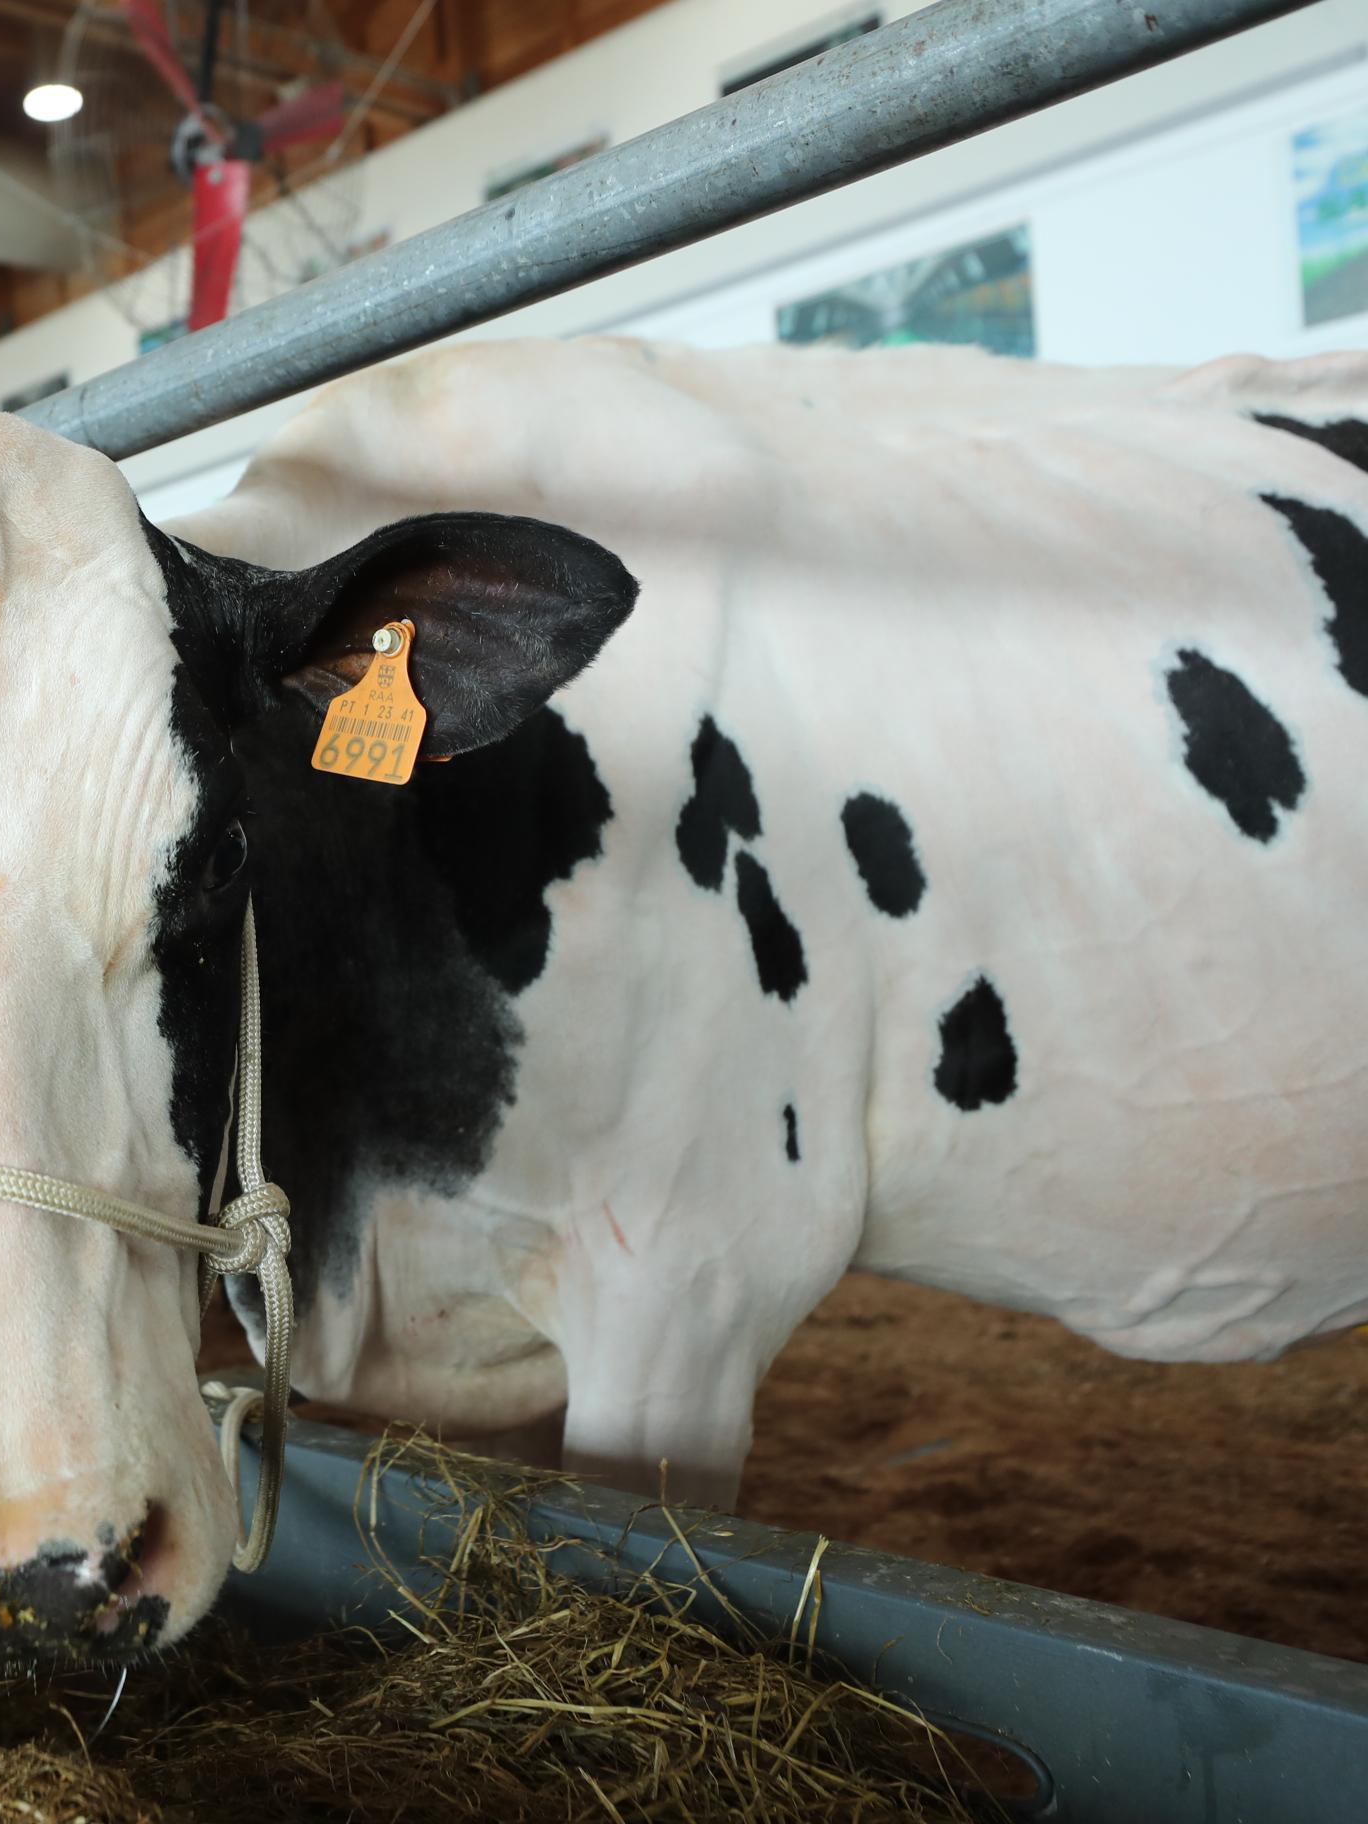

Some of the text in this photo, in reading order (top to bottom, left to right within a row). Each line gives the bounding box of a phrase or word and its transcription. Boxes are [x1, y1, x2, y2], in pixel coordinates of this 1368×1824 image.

[369, 690, 394, 701] RAA
[340, 700, 355, 714] PT
[377, 705, 393, 720] 23
[401, 709, 414, 723] 41
[319, 733, 406, 780] 6991
